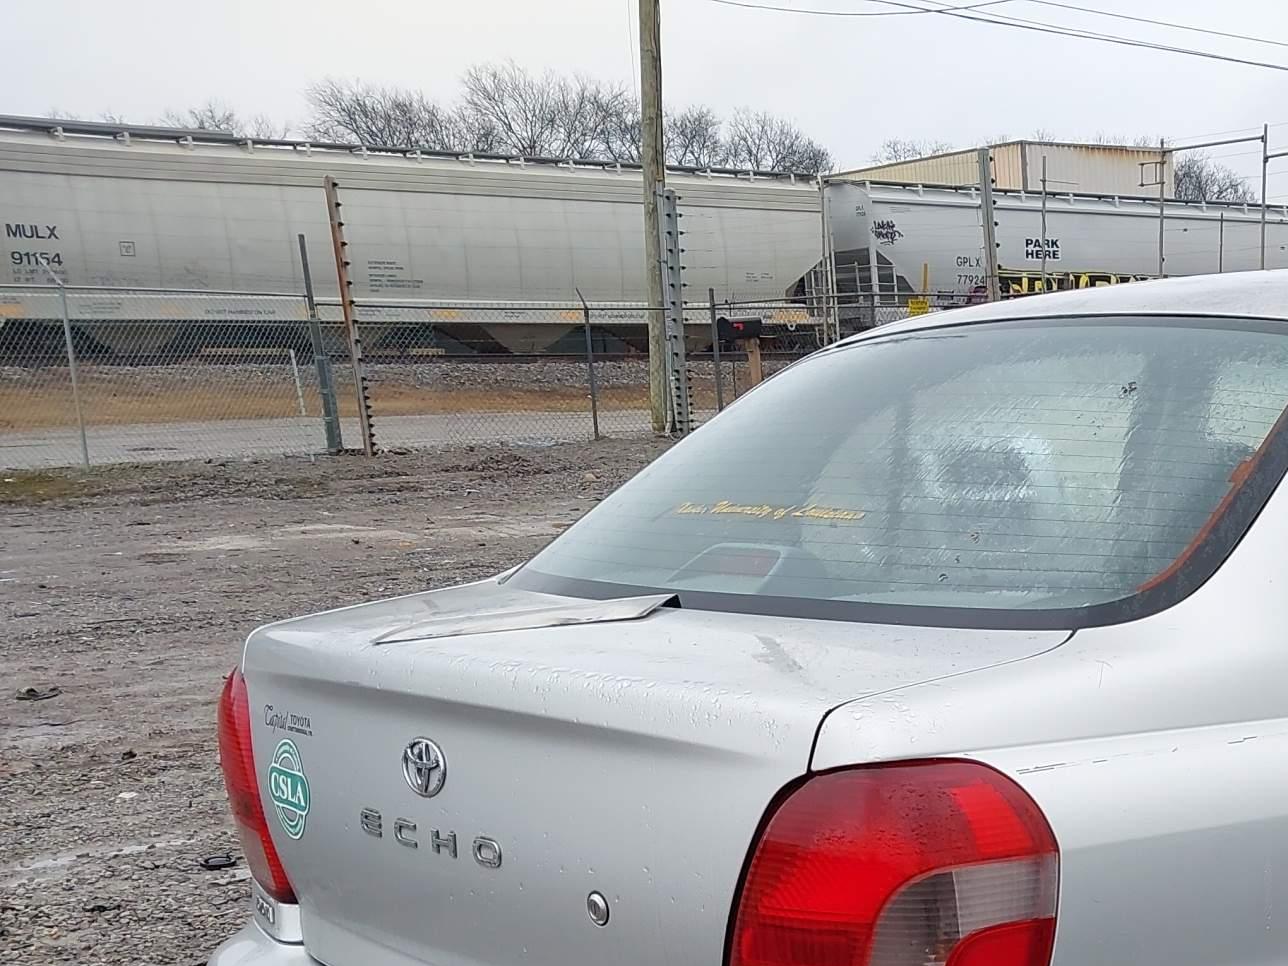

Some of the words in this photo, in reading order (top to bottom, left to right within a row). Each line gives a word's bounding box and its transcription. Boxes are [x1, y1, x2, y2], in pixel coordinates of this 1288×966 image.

[5, 223, 59, 240] MULX
[1025, 238, 1060, 249] PARK
[11, 251, 63, 266] 91154
[1025, 249, 1060, 260] HERE
[290, 714, 311, 729] TOYOTA
[271, 771, 306, 807] CSLA
[360, 808, 502, 868] ECHO
